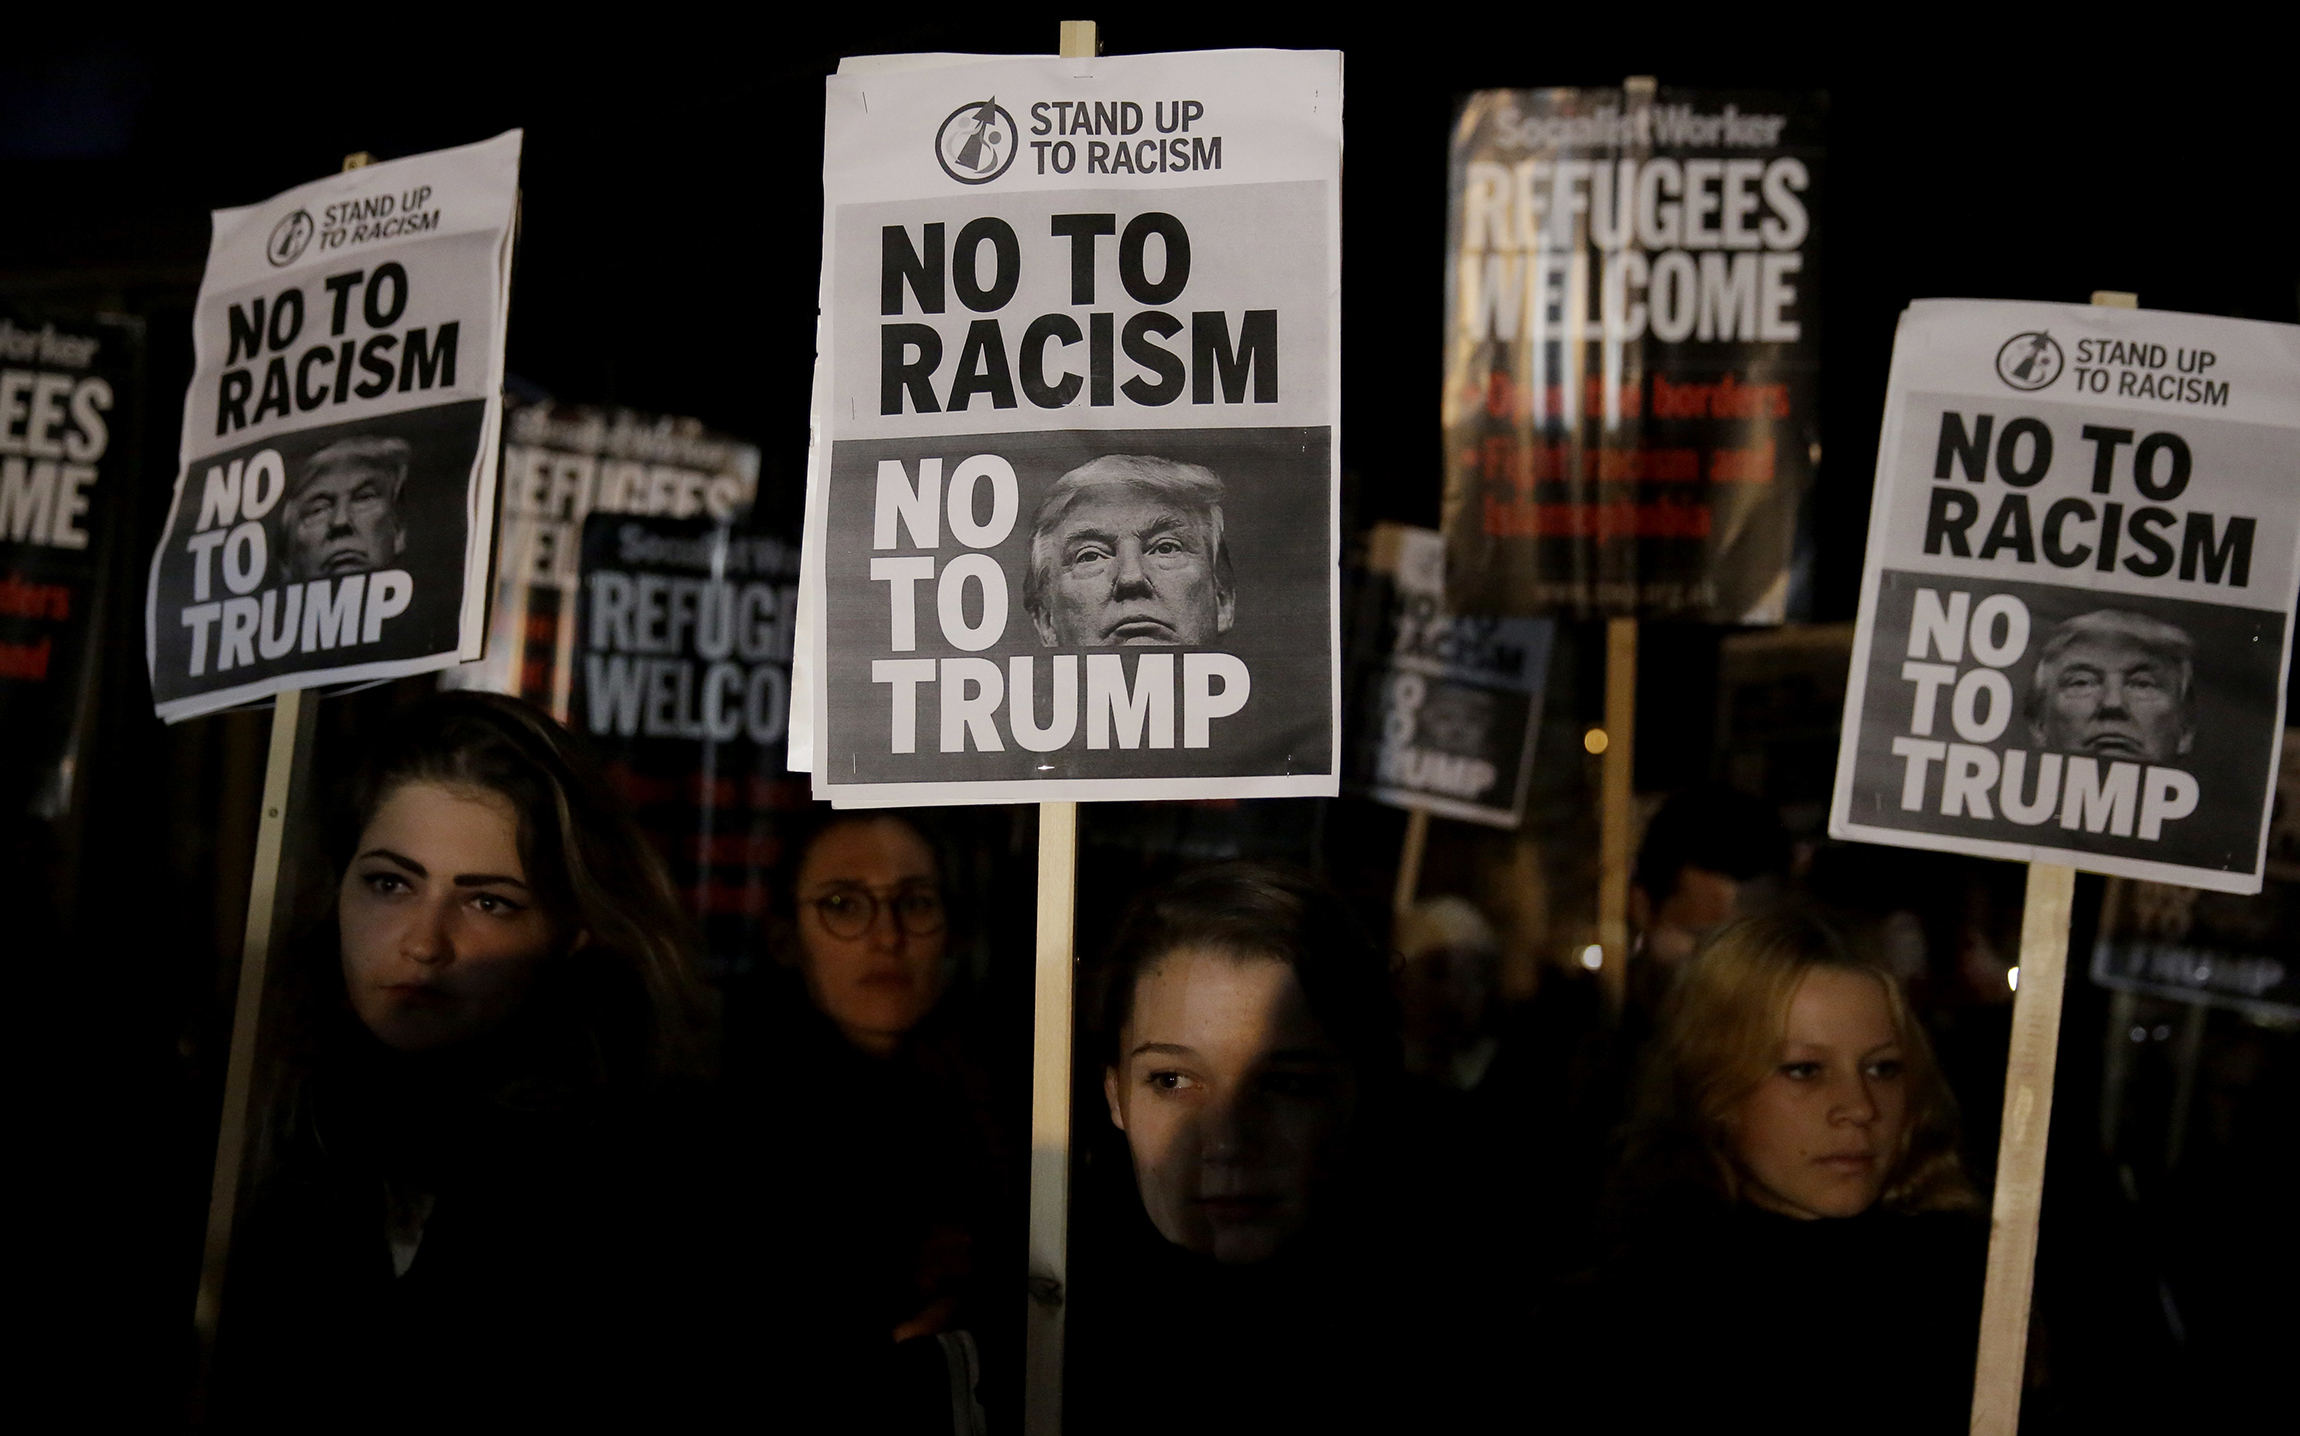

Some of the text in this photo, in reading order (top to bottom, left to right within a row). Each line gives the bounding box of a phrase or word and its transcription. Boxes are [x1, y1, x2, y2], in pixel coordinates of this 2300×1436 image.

[1030, 100, 1204, 136] STAND UP
[1030, 136, 1222, 174] TO RACISM
[1651, 102, 1787, 148] Worker
[320, 209, 442, 251] TO RACISM
[321, 185, 432, 228] STAND UP
[1464, 156, 1809, 250] REFUGEES
[881, 211, 1191, 316] NO TO
[1459, 250, 1804, 343] WELCOME
[226, 261, 409, 367] NO TO
[2076, 338, 2217, 375] STAND UP
[216, 320, 460, 437] RACISM
[880, 308, 1278, 416] RACISM
[2073, 366, 2231, 407] TO RACISM
[195, 449, 286, 533] NO
[873, 453, 1019, 550] NO
[1933, 410, 2193, 503] NO TO
[186, 520, 268, 602] TO
[1923, 487, 2257, 589] RACISM
[181, 568, 414, 678] TRUMP
[870, 553, 1009, 652] TO
[1906, 587, 2031, 669] NO
[585, 652, 791, 746] WELCO
[871, 652, 1251, 754] TRUMP
[1901, 660, 2014, 744] TO
[1891, 736, 2200, 842] TRUMP
